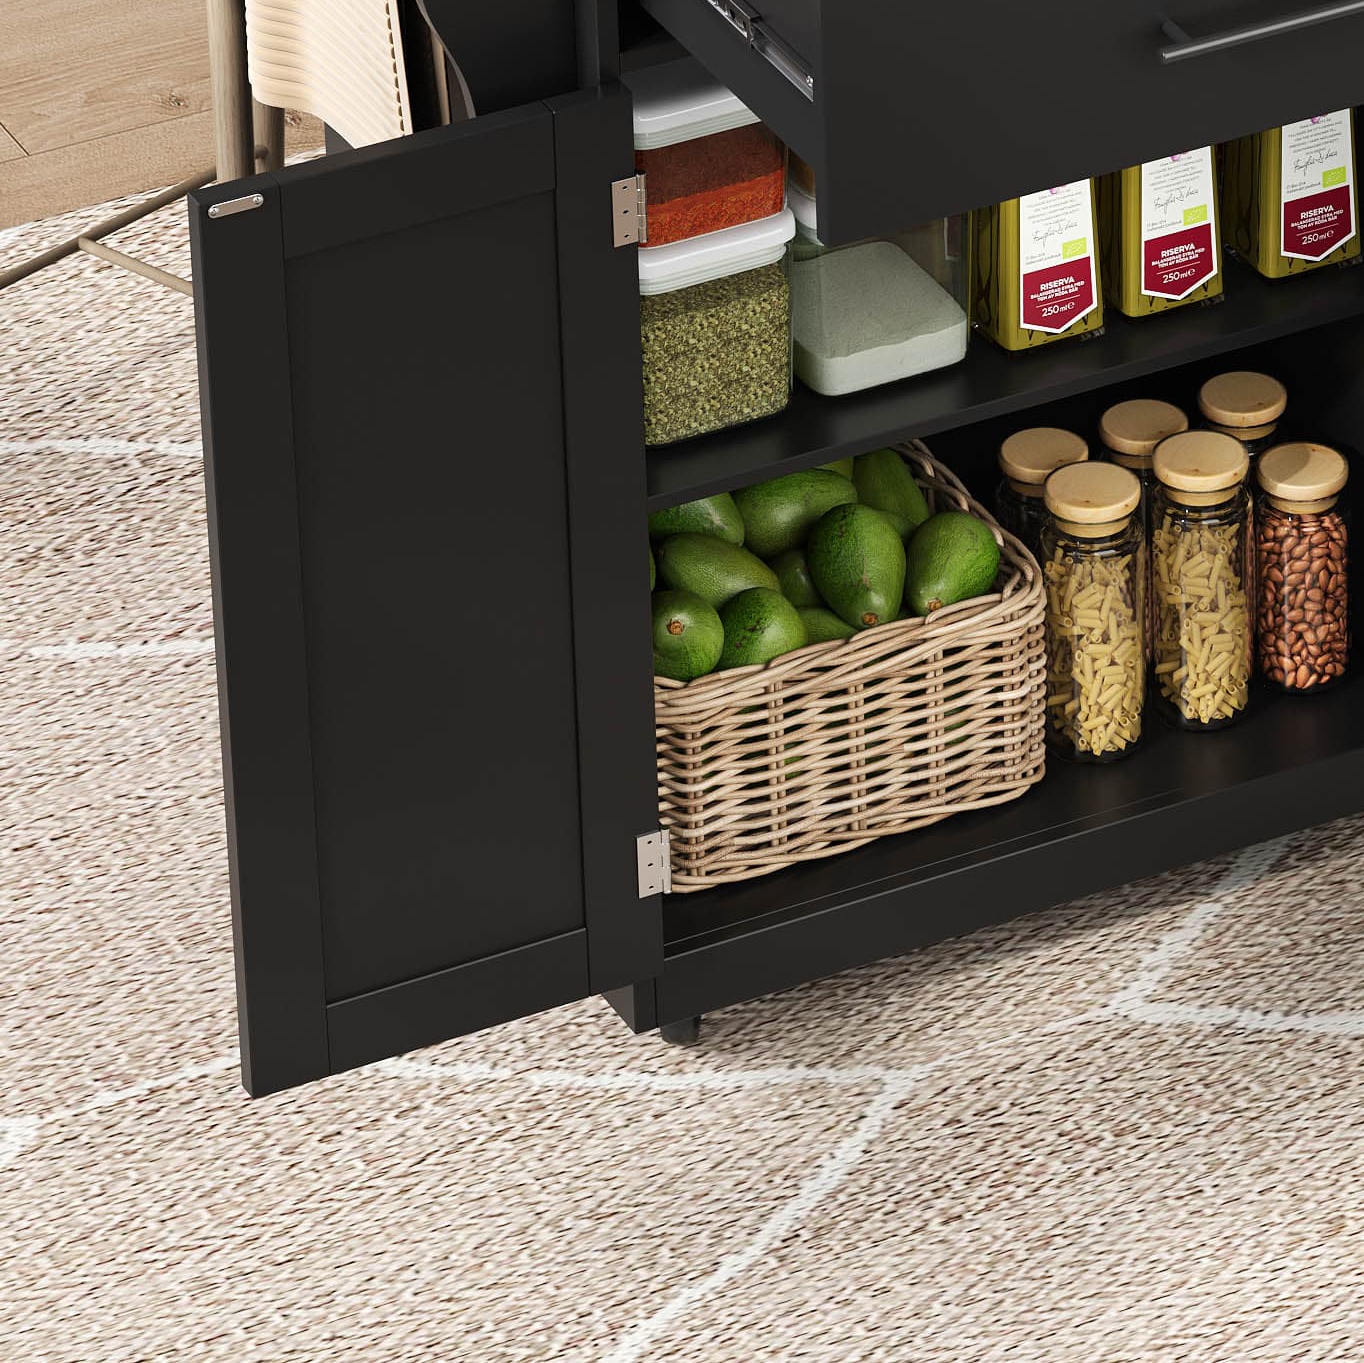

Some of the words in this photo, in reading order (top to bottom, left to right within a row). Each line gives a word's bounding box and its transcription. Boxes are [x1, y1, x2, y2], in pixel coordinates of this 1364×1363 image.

[1300, 205, 1334, 220] RISERVA
[1161, 243, 1196, 258] RISERVA
[1040, 276, 1075, 291] RISERVA
